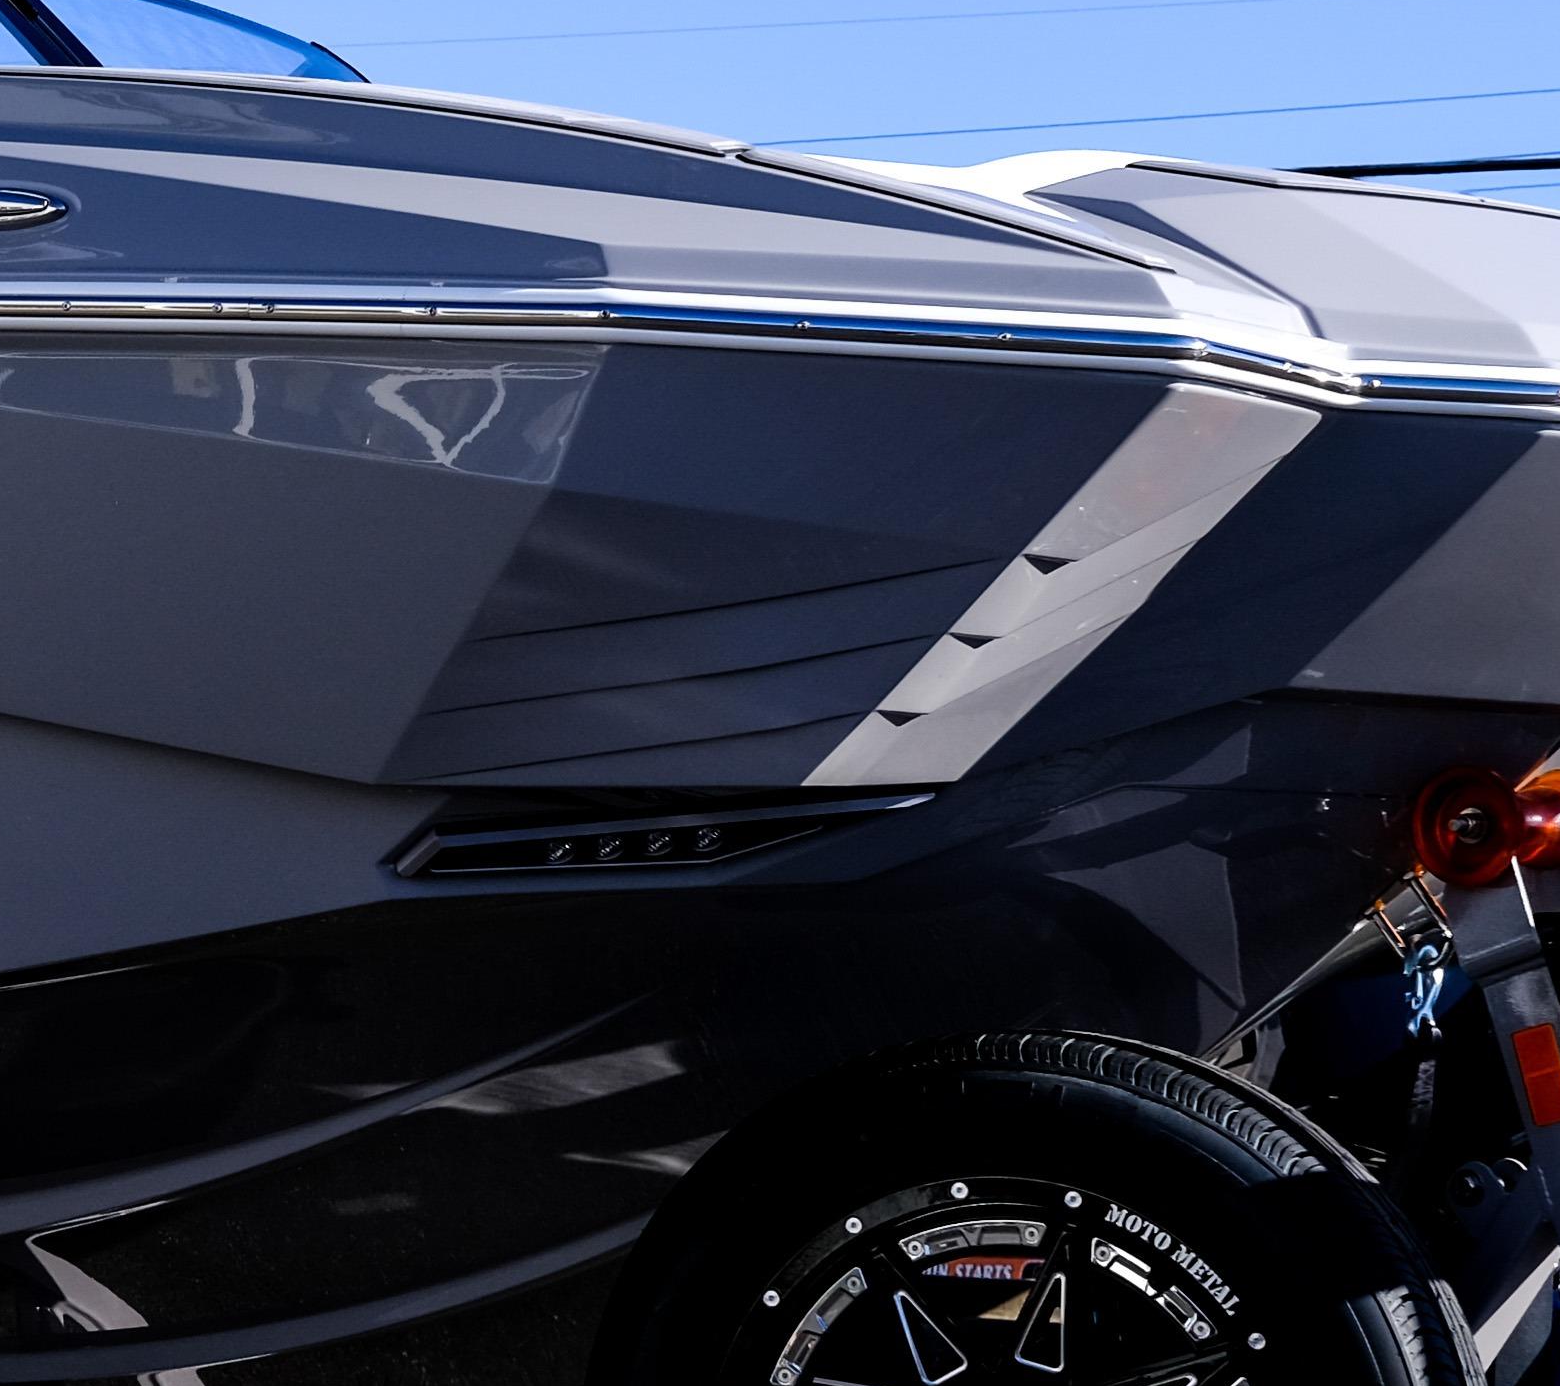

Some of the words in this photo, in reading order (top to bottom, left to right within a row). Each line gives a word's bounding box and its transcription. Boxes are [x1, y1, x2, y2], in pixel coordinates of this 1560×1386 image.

[955, 1263, 1013, 1280] STARTS
[1104, 1203, 1172, 1251] MOTO
[1170, 1244, 1241, 1316] METAL
